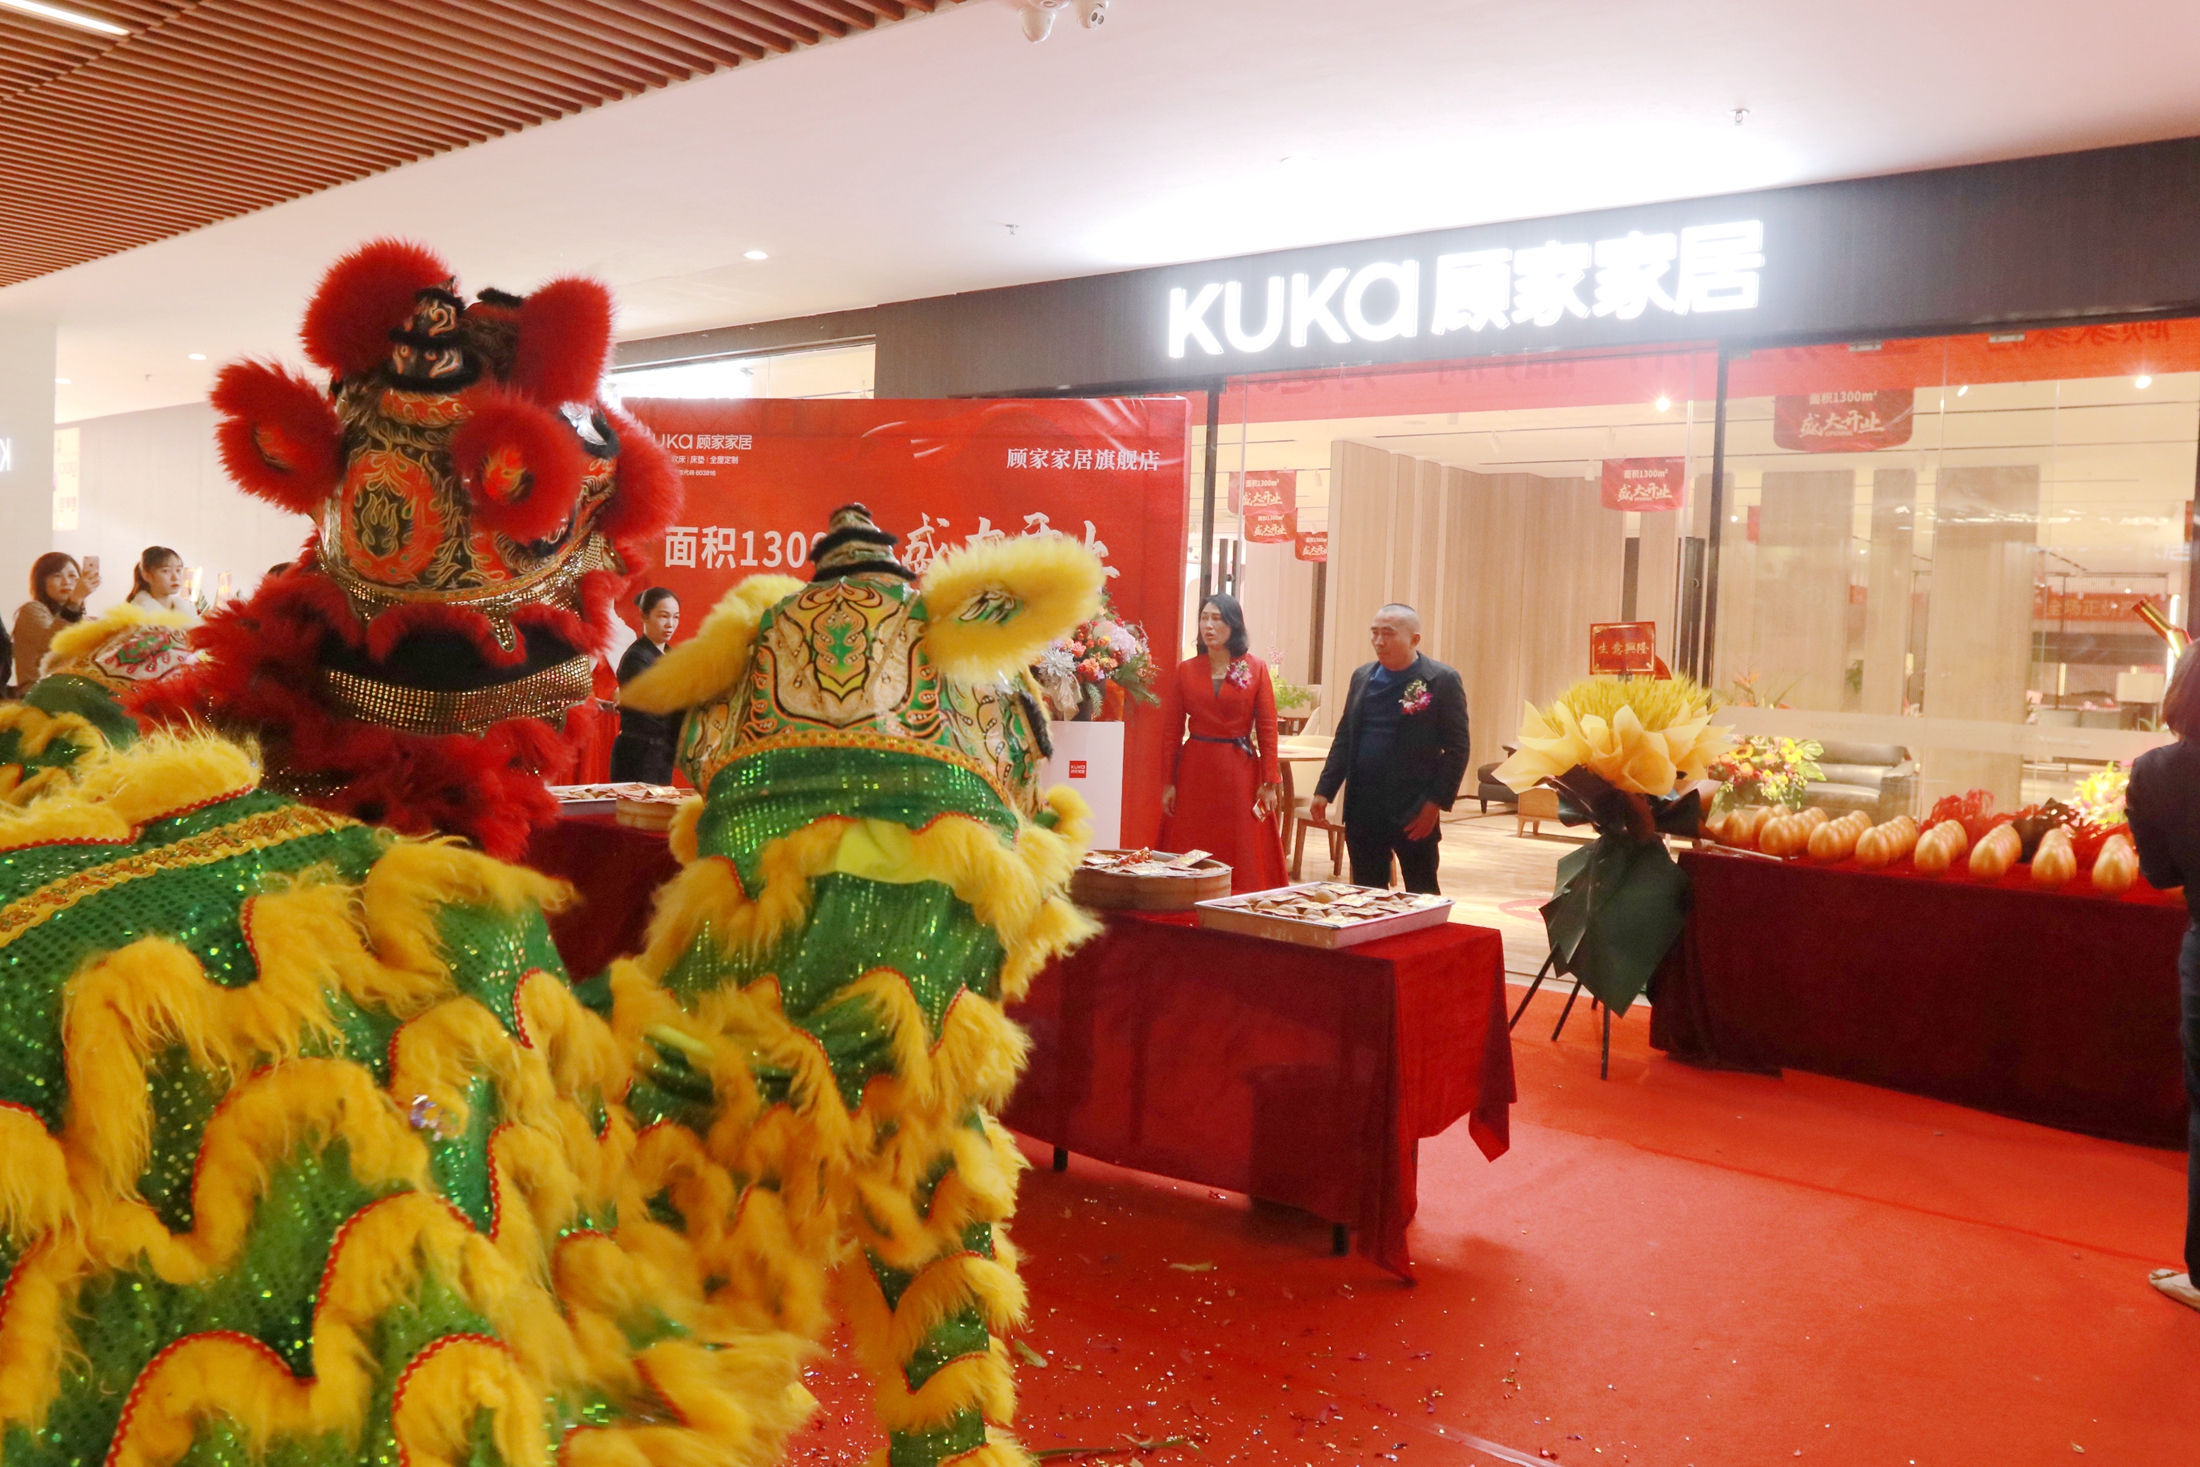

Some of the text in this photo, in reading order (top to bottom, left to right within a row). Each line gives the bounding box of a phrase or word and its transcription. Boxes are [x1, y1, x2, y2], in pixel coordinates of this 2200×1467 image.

[1431, 220, 1764, 335] 顾家家居
[1799, 409, 1885, 438] 盛大开业
[696, 434, 752, 450] 顾家家居
[1006, 448, 1160, 471] 顾家家居旗舰店
[1617, 483, 1673, 502] 盛大开业
